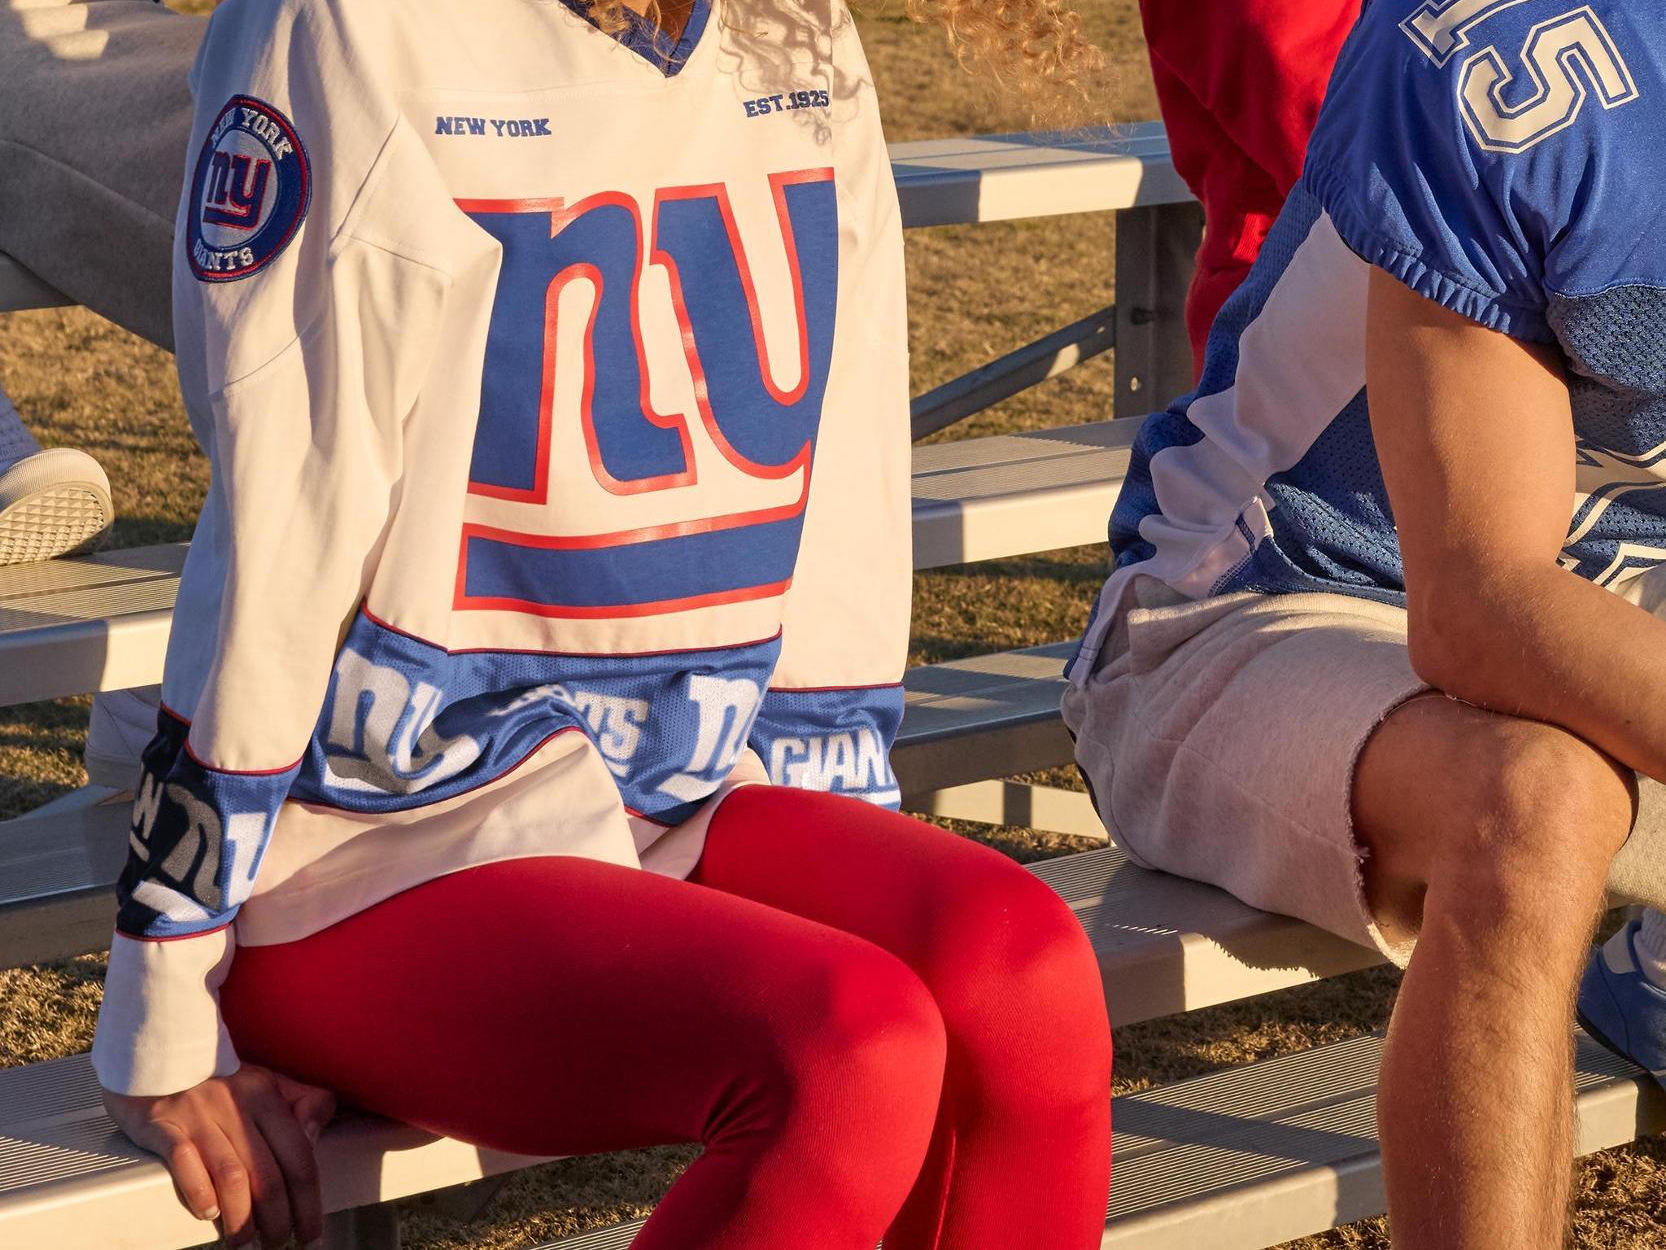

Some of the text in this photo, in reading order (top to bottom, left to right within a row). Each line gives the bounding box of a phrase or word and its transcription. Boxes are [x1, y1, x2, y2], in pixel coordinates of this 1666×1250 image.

[743, 90, 829, 117] EST.1925
[241, 107, 294, 160] YORK
[435, 116, 552, 137] NEW YORK
